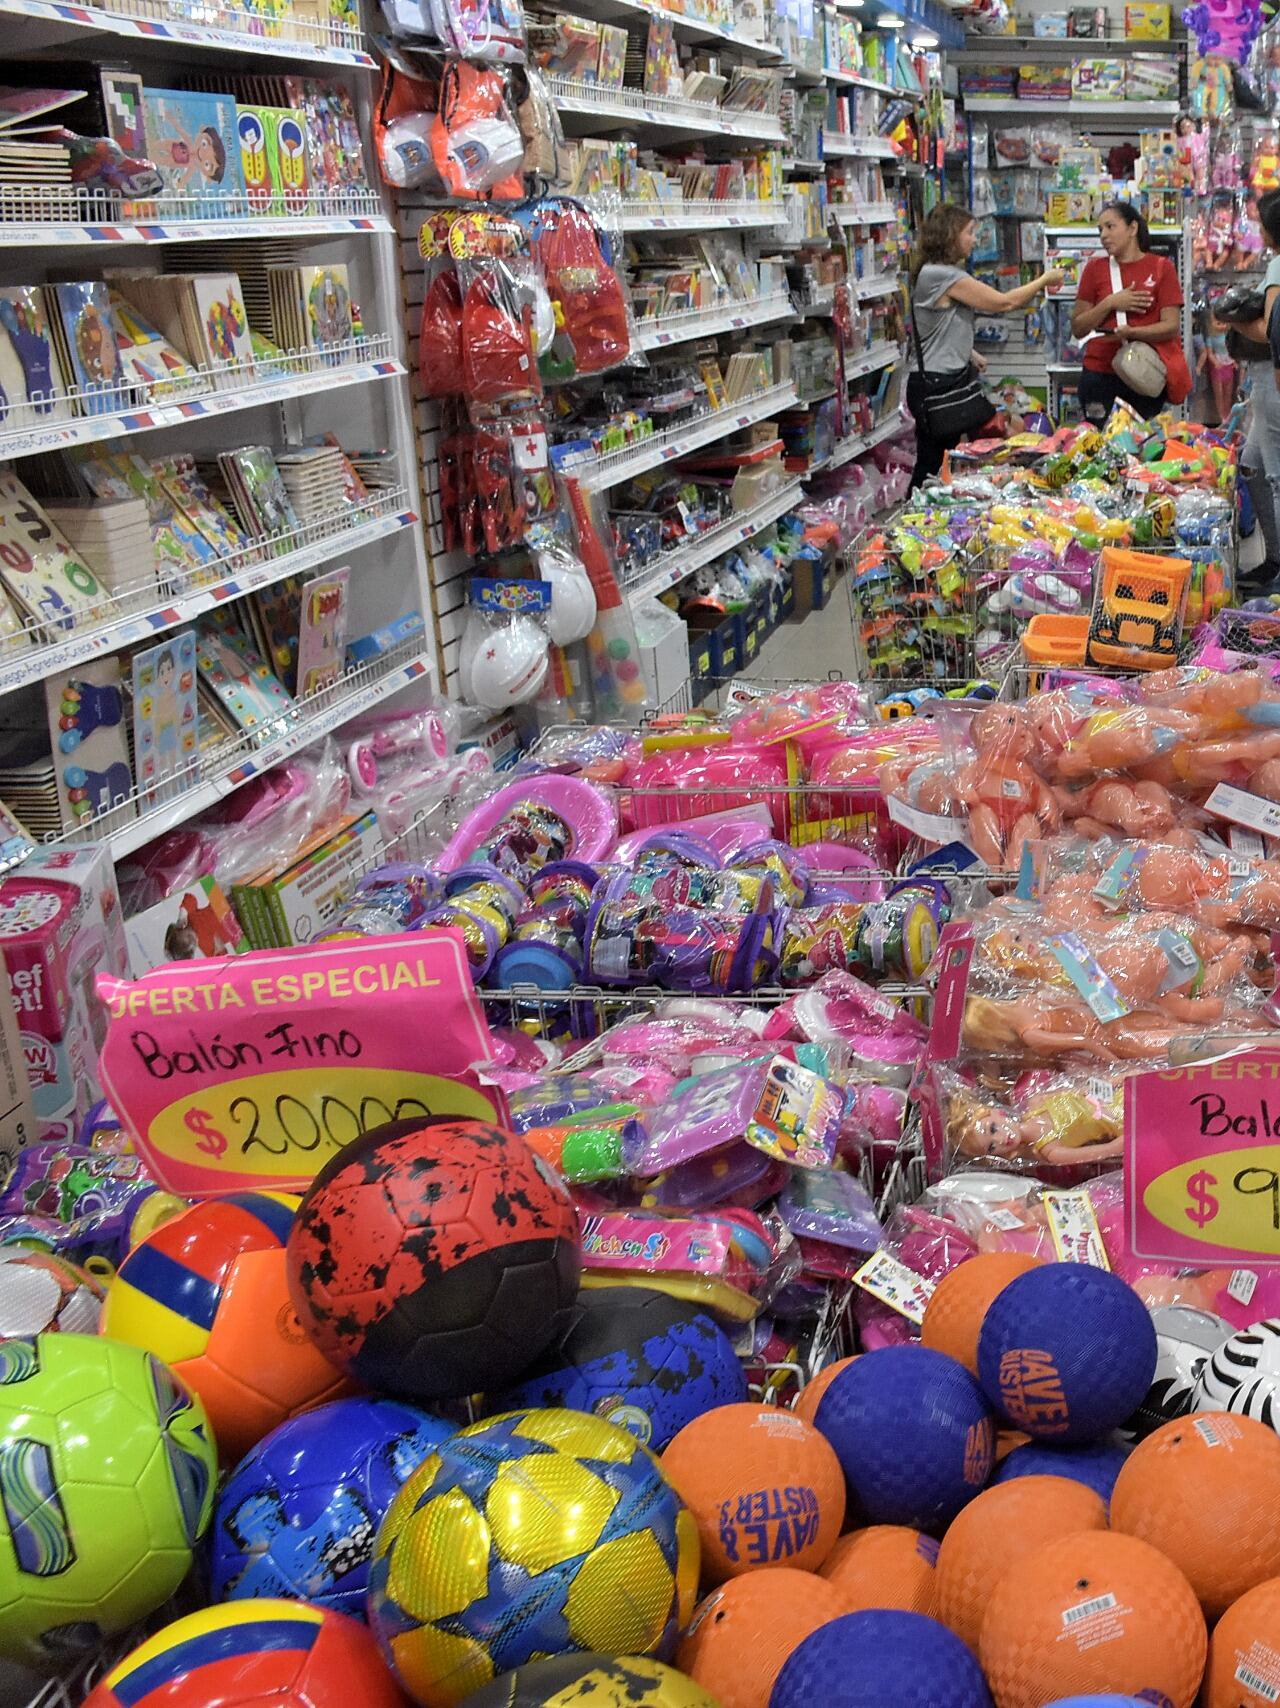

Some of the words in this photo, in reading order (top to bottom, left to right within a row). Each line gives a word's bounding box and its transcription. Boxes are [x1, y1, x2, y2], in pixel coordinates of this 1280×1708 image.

[250, 959, 441, 1005] ESPECIAL
[130, 1030, 263, 1079] Balón
[265, 1023, 362, 1058] Fino
[183, 1106, 229, 1160] $
[1184, 1169, 1220, 1229] $
